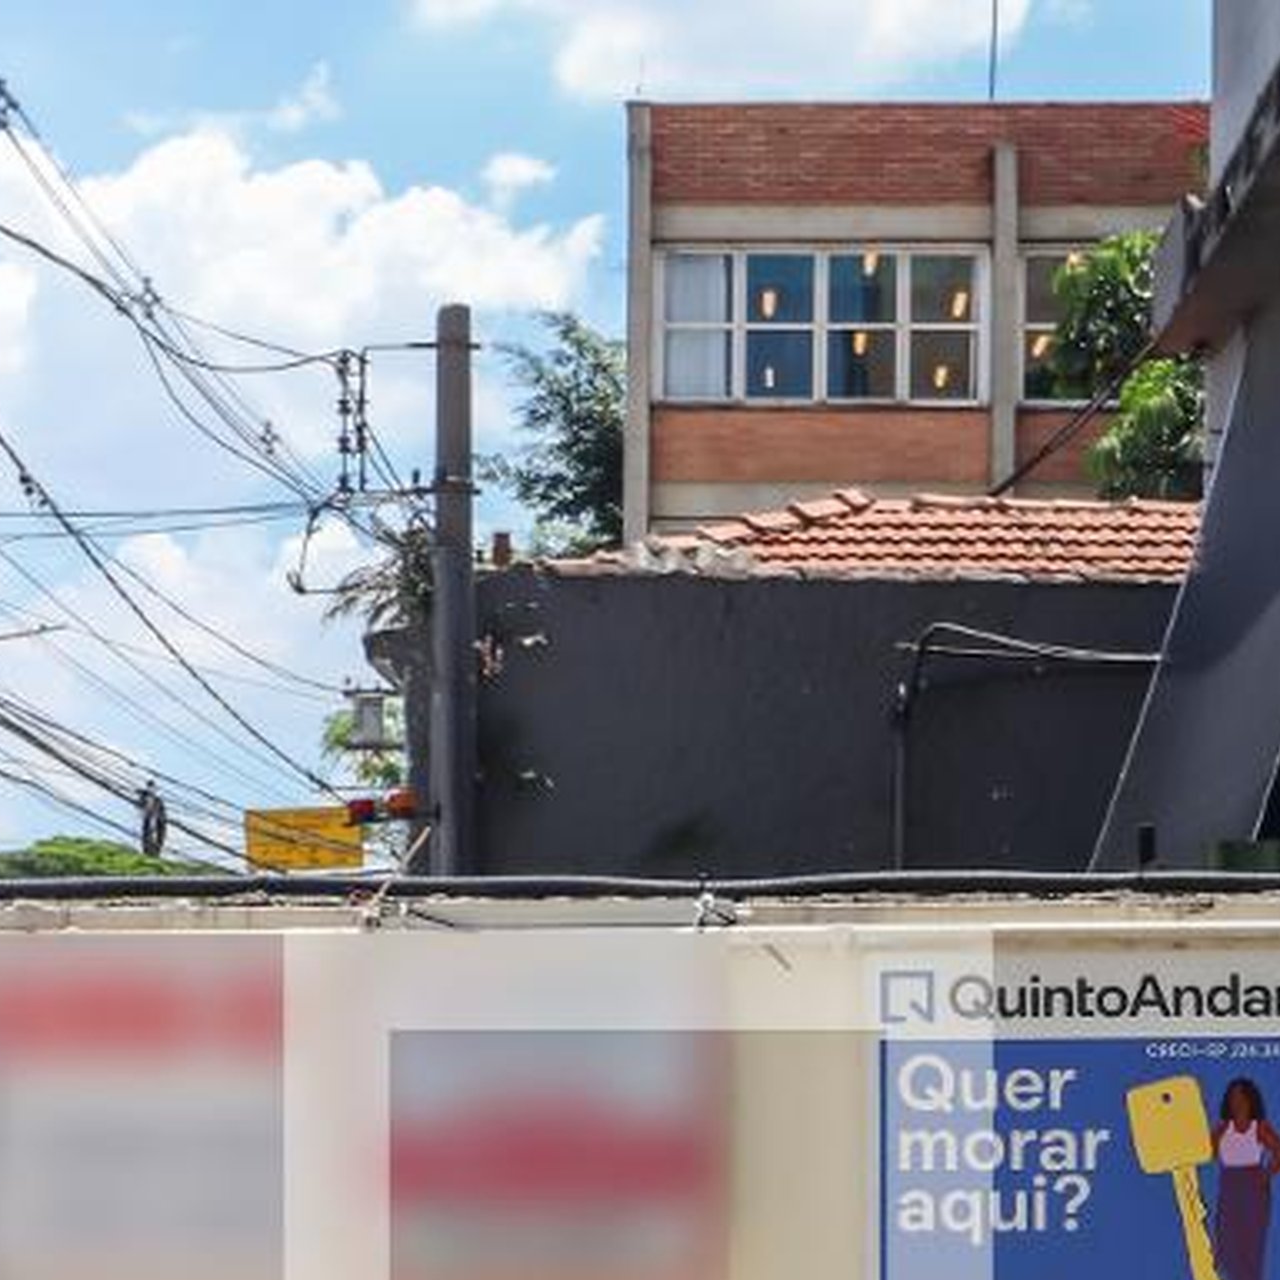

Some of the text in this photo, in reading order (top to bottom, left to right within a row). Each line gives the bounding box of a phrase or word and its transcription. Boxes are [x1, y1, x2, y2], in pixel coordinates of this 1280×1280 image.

[898, 1054, 1077, 1113] Quer
[898, 1127, 1111, 1172] morar
[898, 1174, 1092, 1245] aqui?
